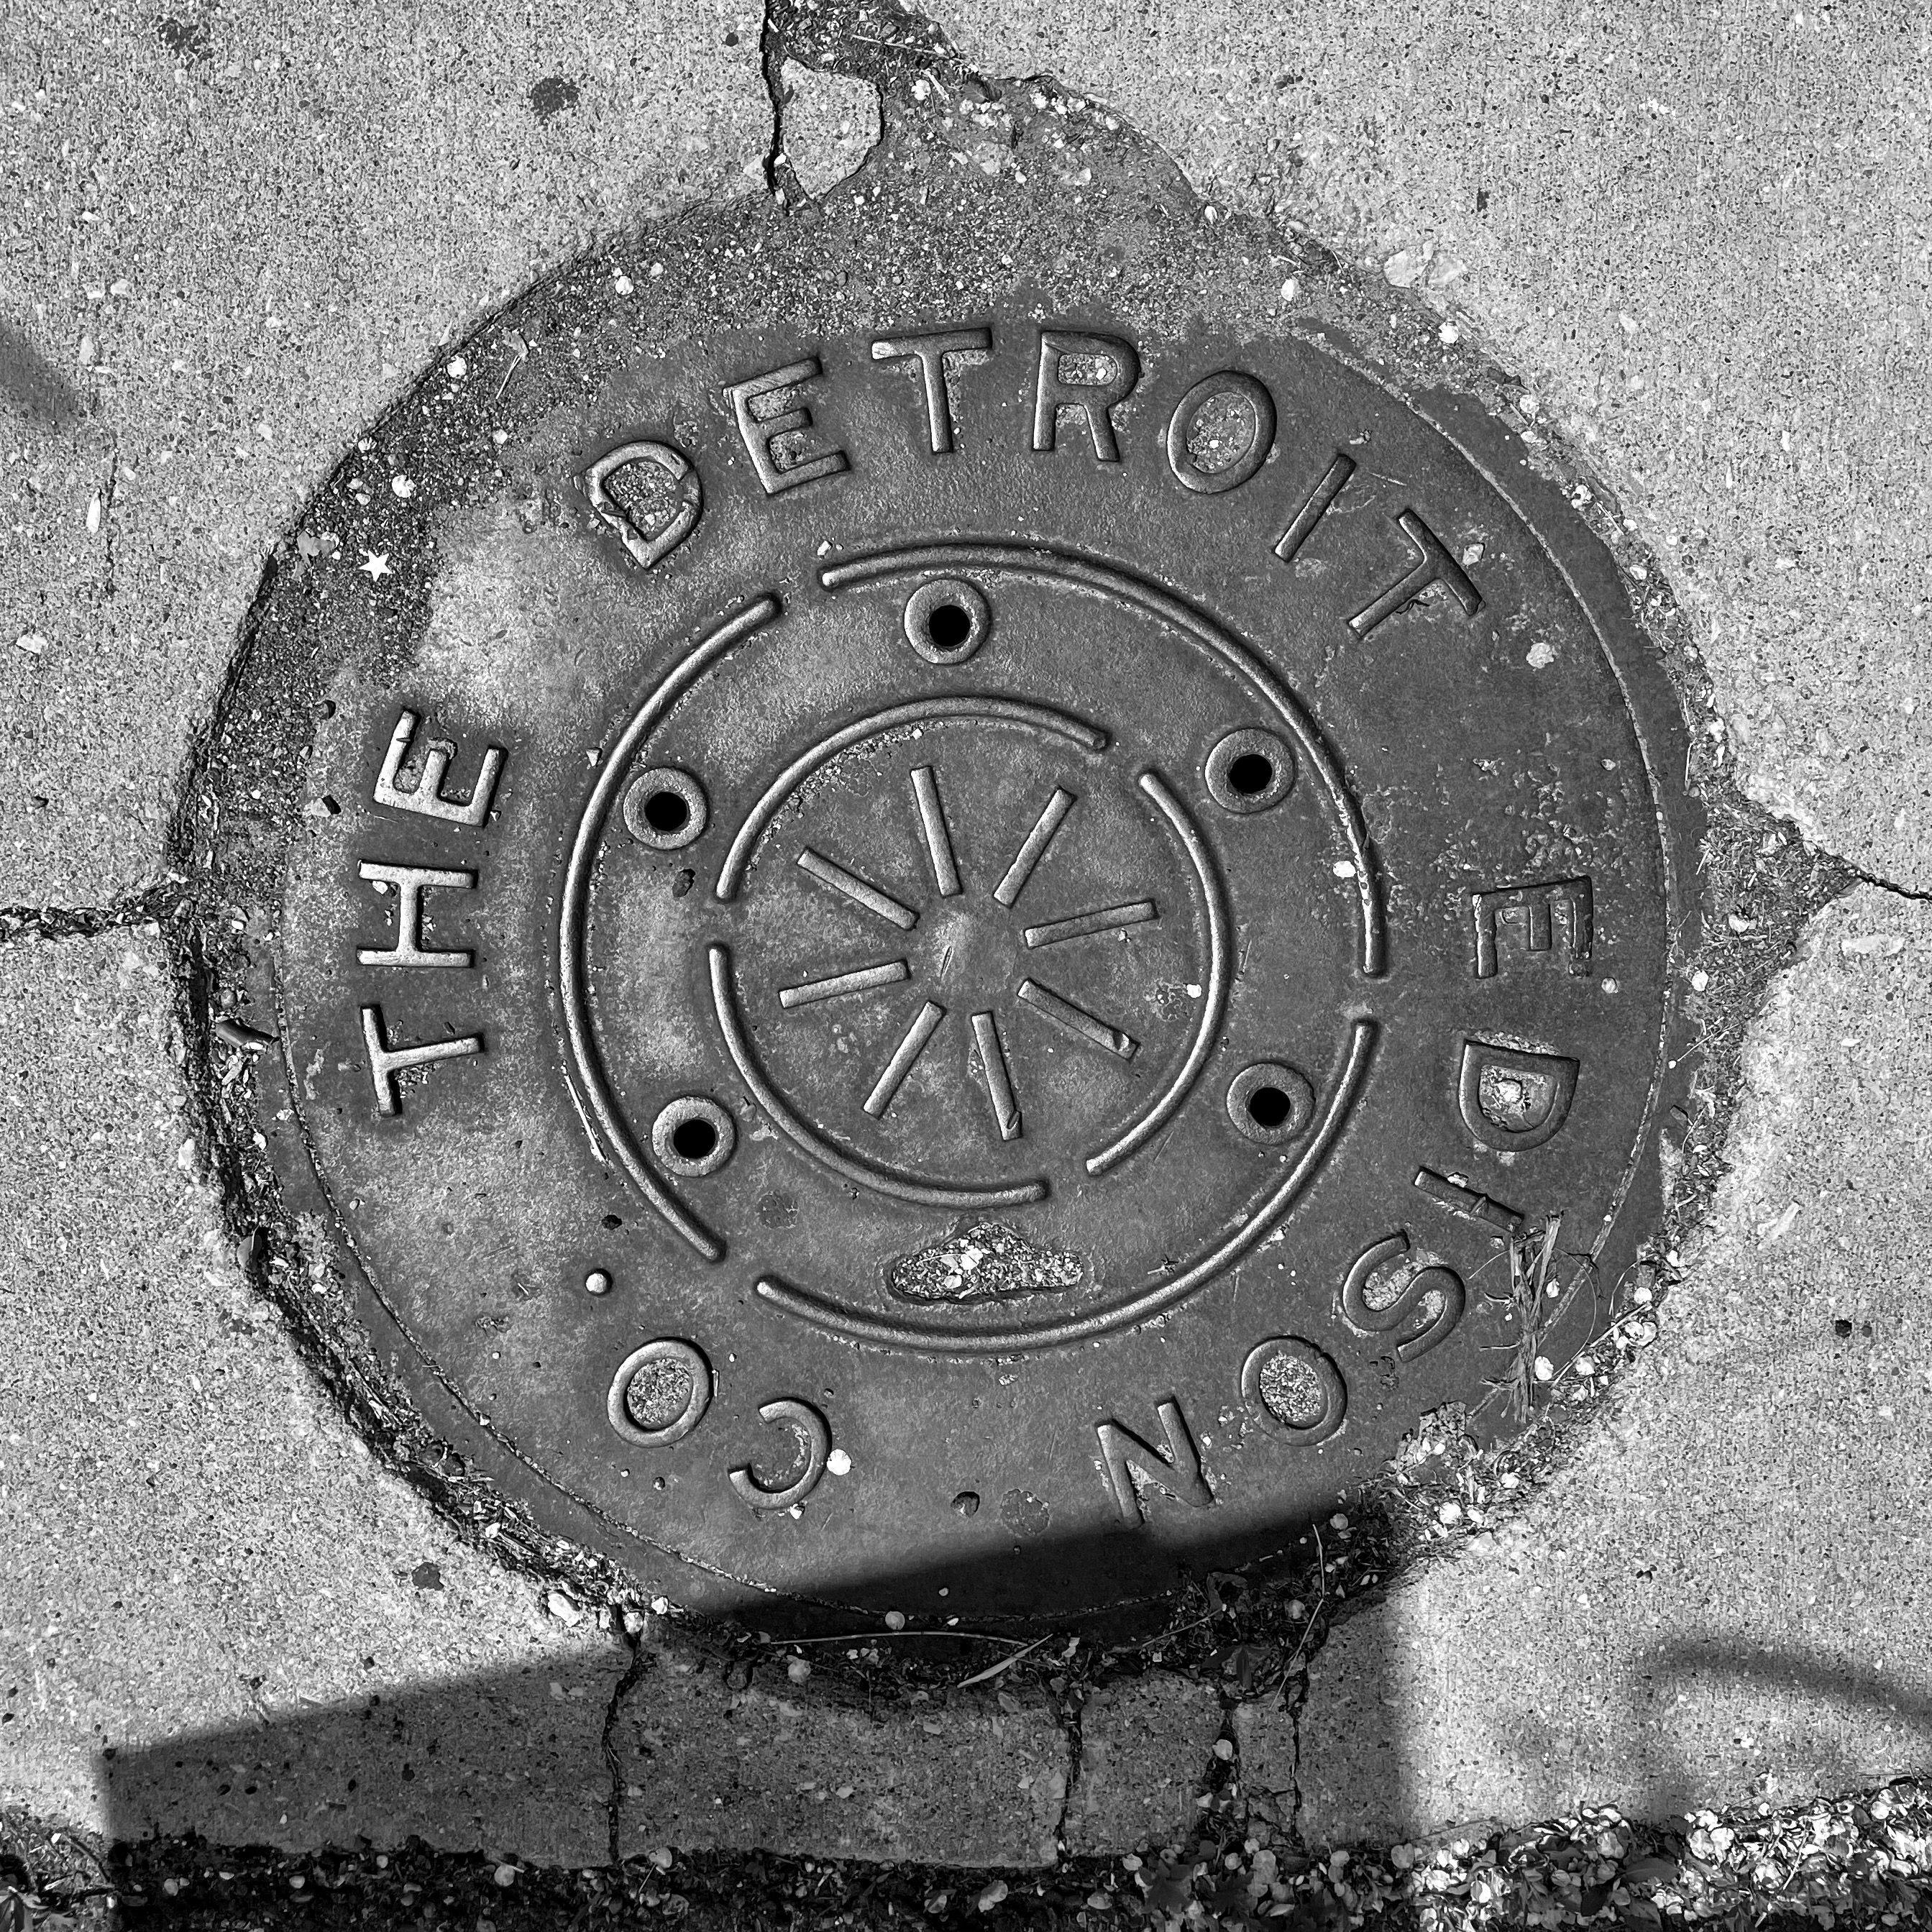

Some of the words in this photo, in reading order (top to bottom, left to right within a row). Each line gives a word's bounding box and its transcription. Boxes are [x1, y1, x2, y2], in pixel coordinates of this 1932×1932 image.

[357, 708, 507, 1116] THE
[575, 326, 1485, 638] DETROIT
[1097, 877, 1591, 1529] EDISON
